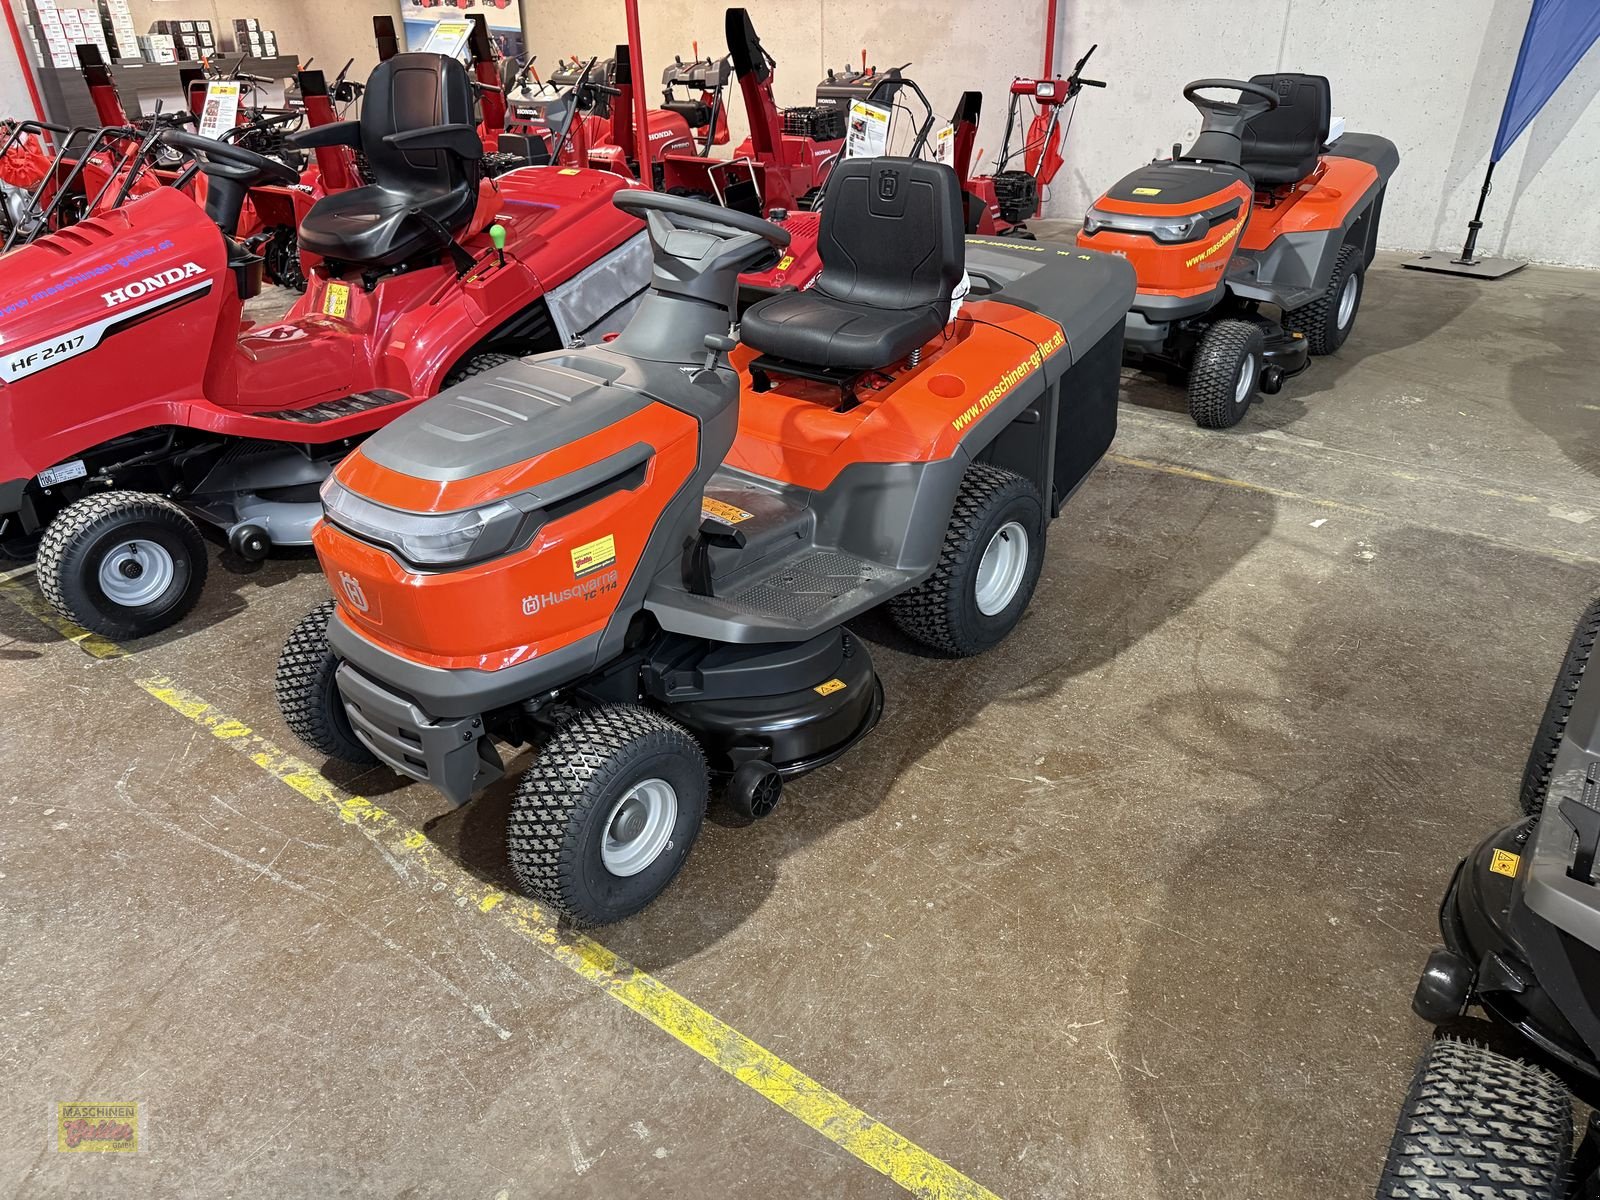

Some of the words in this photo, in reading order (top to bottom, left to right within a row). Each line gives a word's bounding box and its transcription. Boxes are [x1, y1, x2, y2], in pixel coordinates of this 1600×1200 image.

[516, 108, 538, 116] HONDA
[648, 130, 674, 141] HONDA
[0, 239, 175, 318] ww.maschinen-gailer.at
[101, 261, 206, 308] HONDA
[11, 353, 38, 373] HF
[42, 334, 86, 362] 2417
[951, 330, 1065, 432] www.maschinen-gailer.at
[541, 569, 619, 608] Husqvarna
[583, 591, 597, 602] TC
[599, 580, 618, 595] 114
